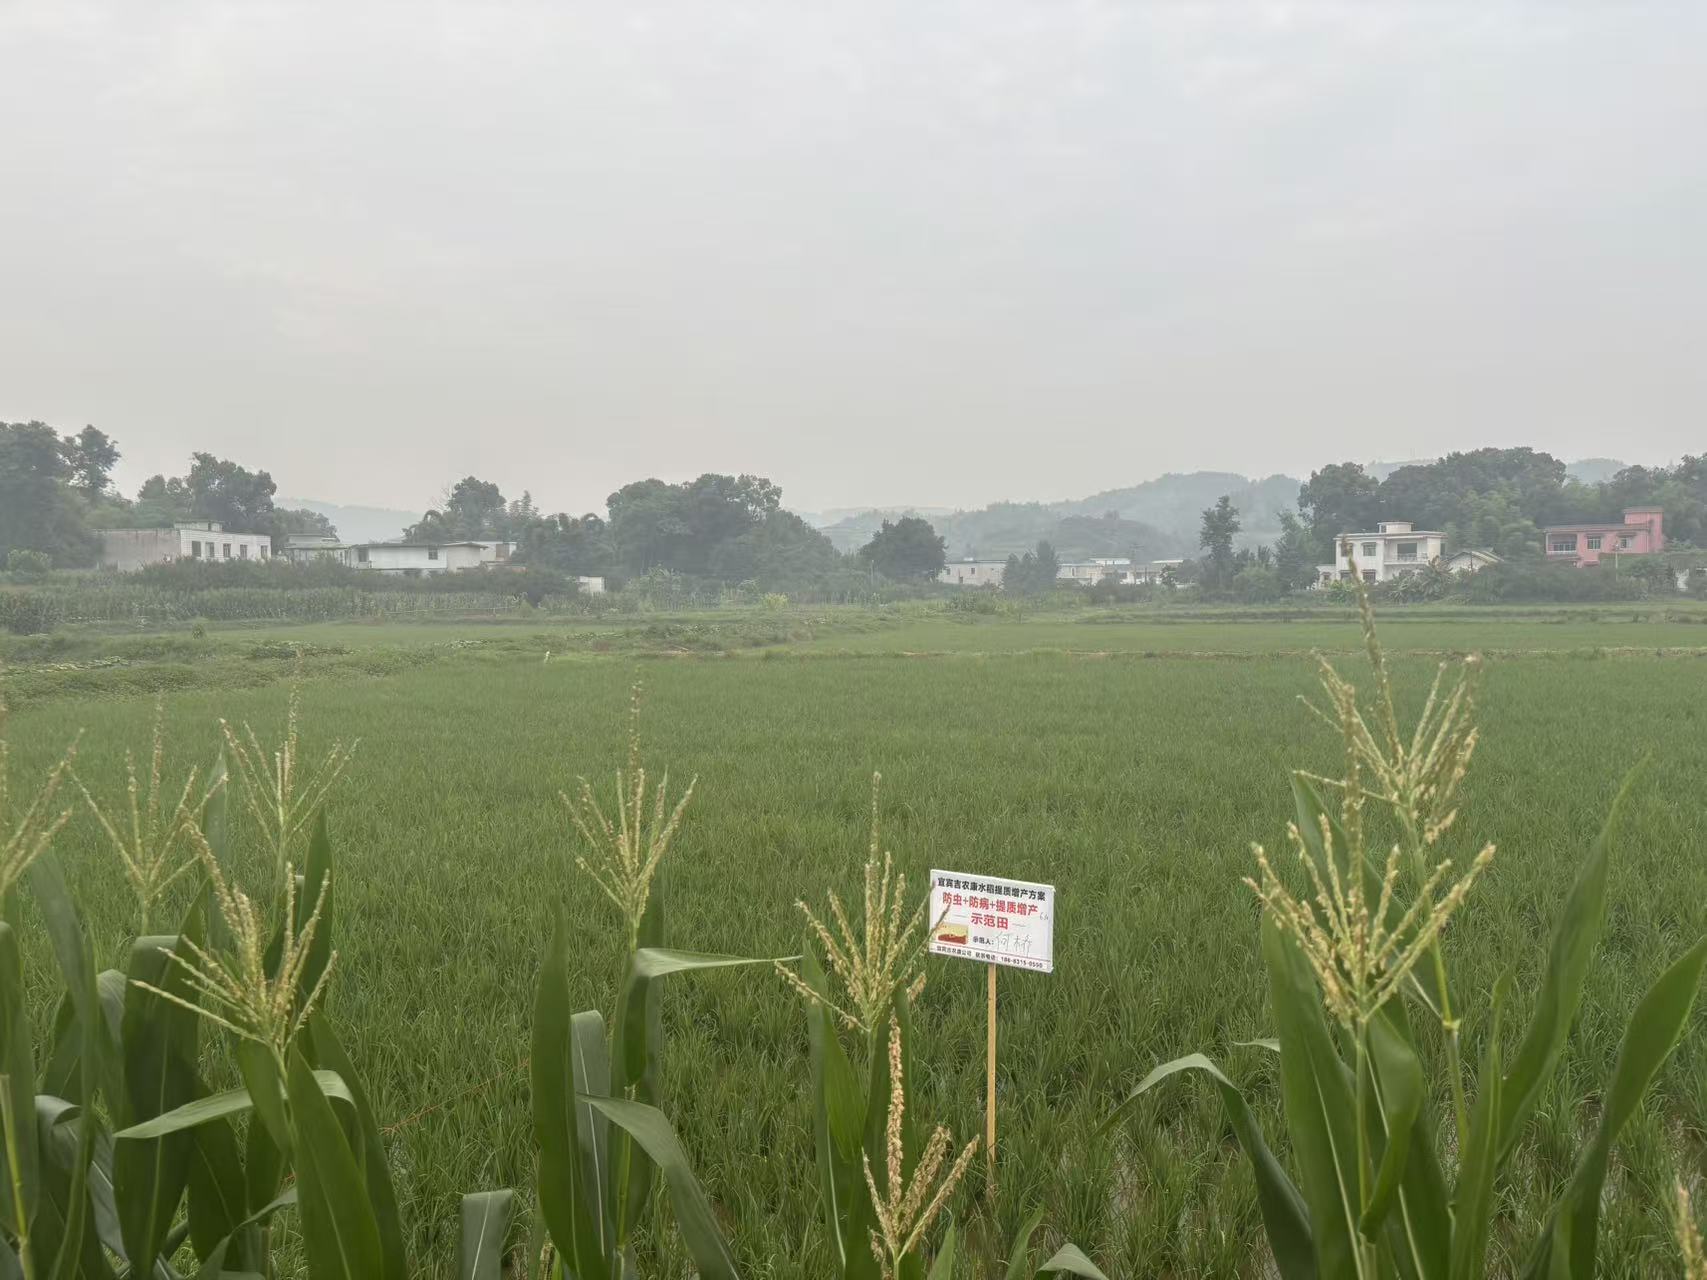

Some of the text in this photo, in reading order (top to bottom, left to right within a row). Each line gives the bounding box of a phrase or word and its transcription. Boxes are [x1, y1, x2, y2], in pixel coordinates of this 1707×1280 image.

[942, 892, 1039, 916] 防虫+防病+提质增产
[971, 912, 1009, 930] 示范田
